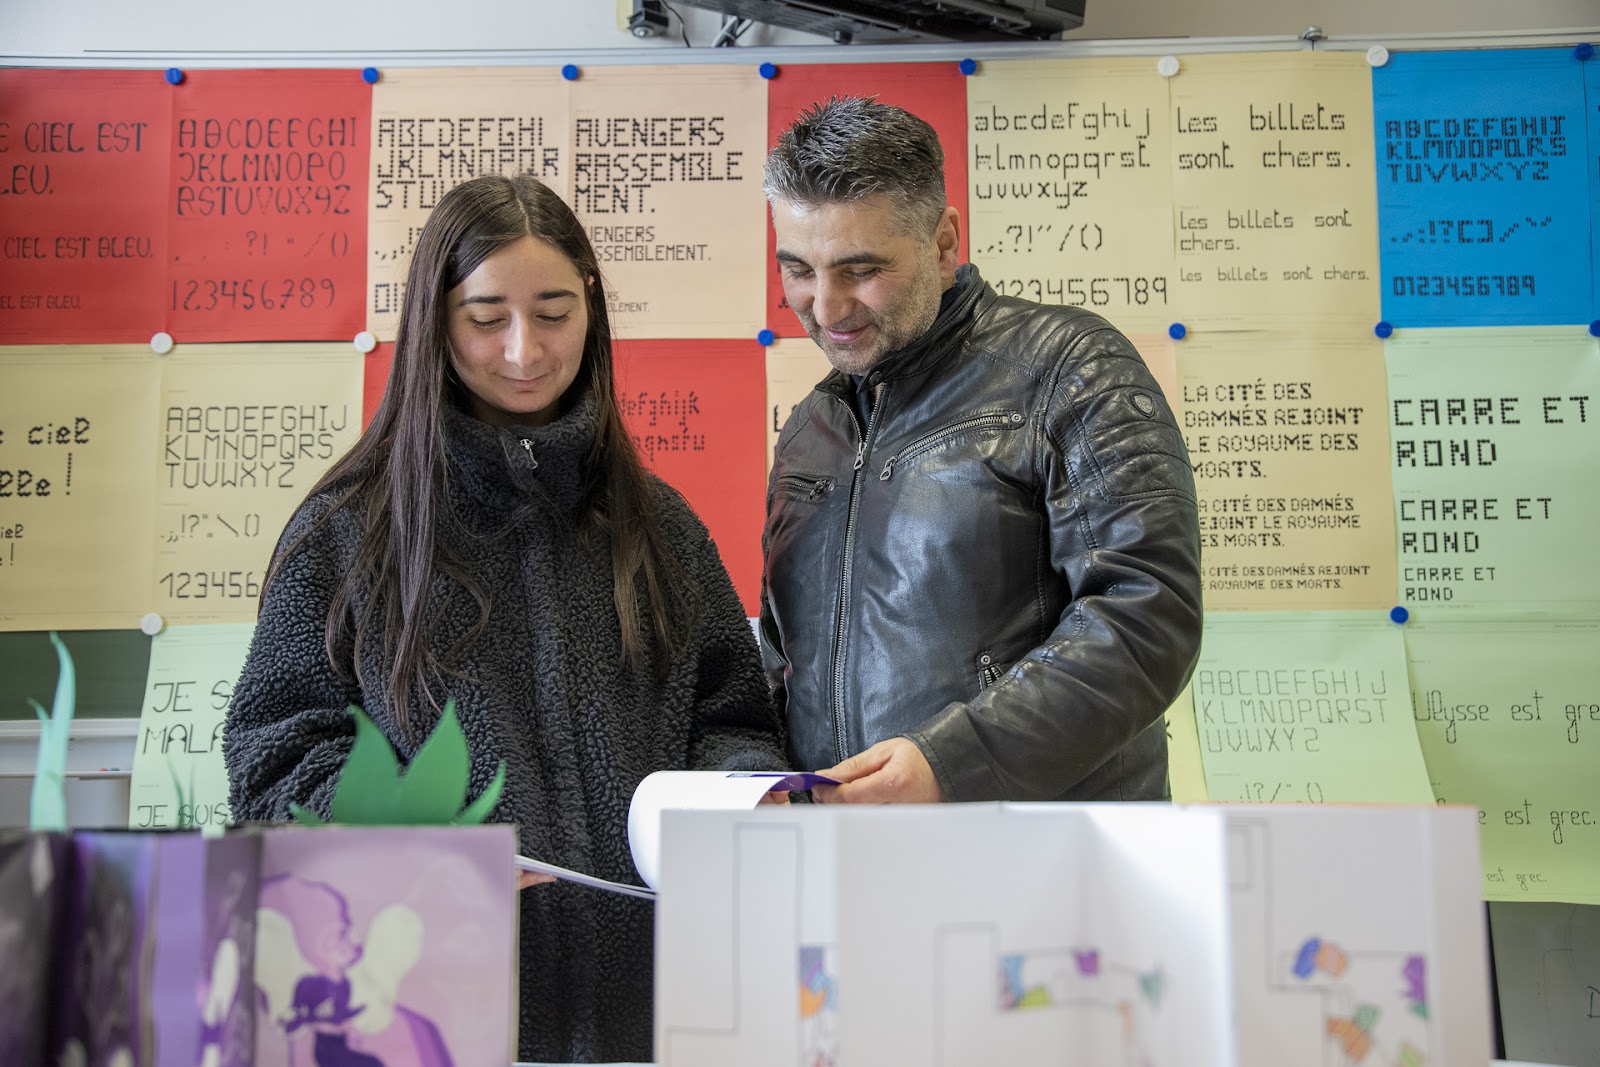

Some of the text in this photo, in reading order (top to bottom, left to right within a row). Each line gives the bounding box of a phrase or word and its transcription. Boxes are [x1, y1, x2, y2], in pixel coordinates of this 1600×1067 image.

[975, 102, 1150, 140] abcdefghij
[1250, 103, 1346, 131] billets
[25, 122, 84, 152] CIEL
[97, 122, 147, 152] EST
[378, 116, 544, 148] ABCDEFGHI
[575, 117, 725, 147] AVENGERS
[975, 141, 1150, 180] klmnopqrst
[1178, 140, 1351, 170] sont chers.
[1386, 137, 1567, 160] KLMNOPQRS
[1387, 161, 1549, 183] TUVWXYZ
[573, 184, 656, 213] MENT.
[976, 182, 1088, 209] uvwxyz
[1227, 208, 1294, 229] billets
[1314, 208, 1352, 228] sont
[4, 236, 46, 259] CIEL
[55, 236, 90, 259] EST
[1180, 232, 1241, 251] chers.
[1217, 266, 1268, 281] billets
[1283, 265, 1314, 281] sont
[1323, 265, 1370, 281] chers.
[1393, 274, 1537, 297] 0123456789
[172, 277, 335, 311] 123456789
[1183, 378, 1312, 402] LA CITÉ DES
[166, 404, 348, 433] ABCDEFGHIJ
[1184, 403, 1364, 428] DAMNÉS REJOINT
[1394, 396, 1590, 426] CARRE ET
[165, 433, 334, 461] KLMNOPQRS
[1217, 433, 1314, 453] ROYAUME
[1320, 432, 1359, 452] DES
[1396, 439, 1497, 467] ROND
[164, 460, 295, 489] TUVWXYZ
[1212, 494, 1252, 513] CITÉ
[1256, 497, 1286, 512] DES
[1290, 493, 1355, 512] DAMNÉS
[1400, 498, 1552, 521] CARRE ET
[1263, 515, 1283, 530] LE
[1287, 514, 1361, 529] ROYAUME
[1223, 532, 1286, 548] MORTS.
[1402, 531, 1480, 553] ROND
[1208, 563, 1239, 577] CITÉ
[1242, 566, 1265, 577] DES
[1266, 562, 1315, 576] DAMNÉS
[1318, 565, 1371, 577] REJOINT
[1404, 567, 1496, 581] CARRE ET
[1209, 580, 1266, 591] ROYAUME
[1270, 579, 1294, 590] DES
[1297, 578, 1344, 590] MORTS.
[1405, 587, 1454, 601] ROND
[1200, 669, 1387, 696] ABCDEFGHIJ
[153, 681, 197, 713] JE
[1511, 690, 1543, 721] est
[1202, 698, 1388, 725] KLMNOPQRST
[1206, 727, 1321, 753] UVWXYZ
[137, 805, 168, 828] JE
[1504, 799, 1533, 825] est
[1550, 810, 1597, 845] grec.
